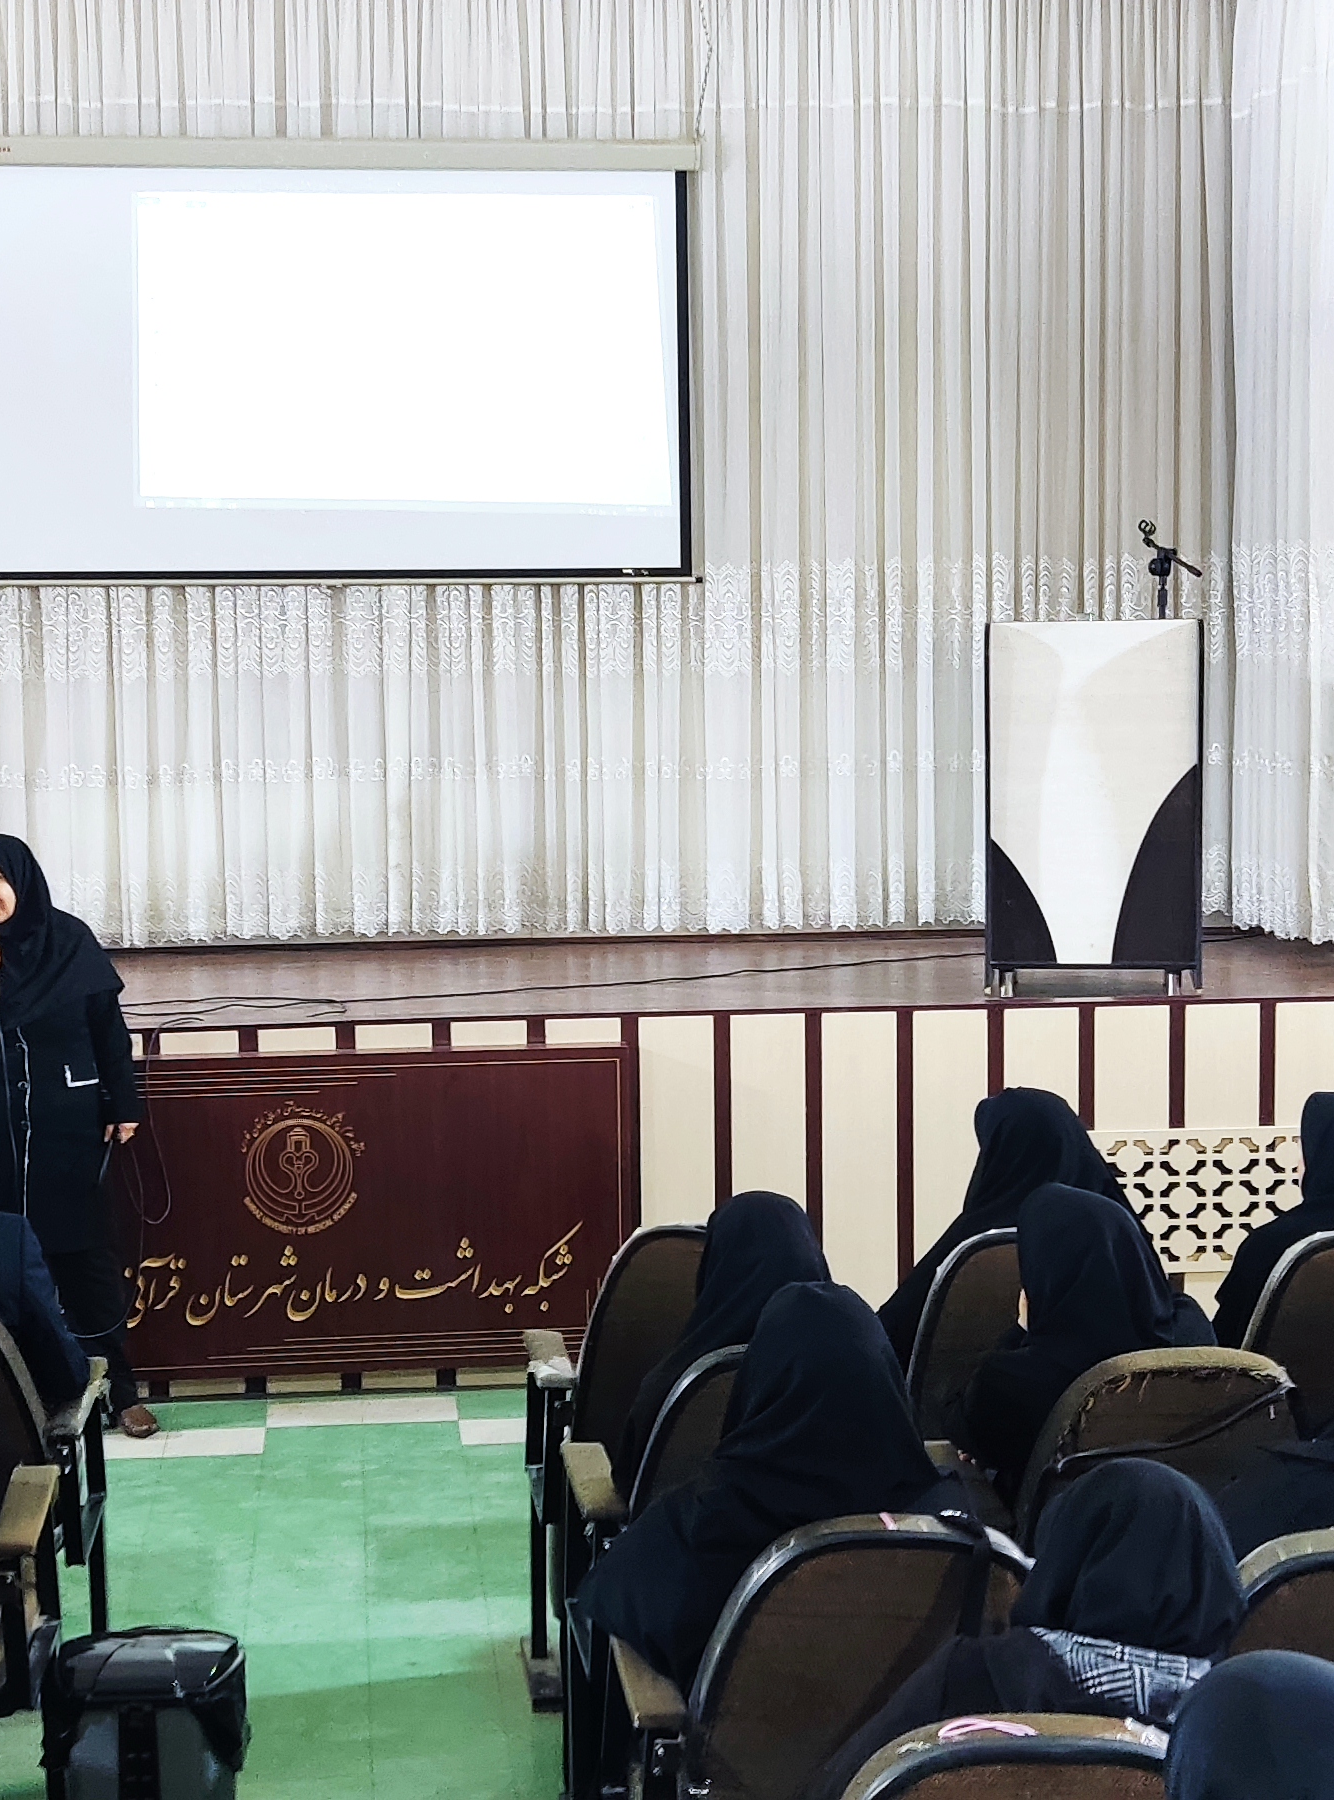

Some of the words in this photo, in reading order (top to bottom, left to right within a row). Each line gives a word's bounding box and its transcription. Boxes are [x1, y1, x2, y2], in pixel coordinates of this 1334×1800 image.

[185, 1244, 299, 1327] شهرستان
[286, 1265, 368, 1323] درمان
[372, 1276, 391, 1302] و
[394, 1236, 524, 1315] بهداشت
[520, 1219, 584, 1313] شبکه
